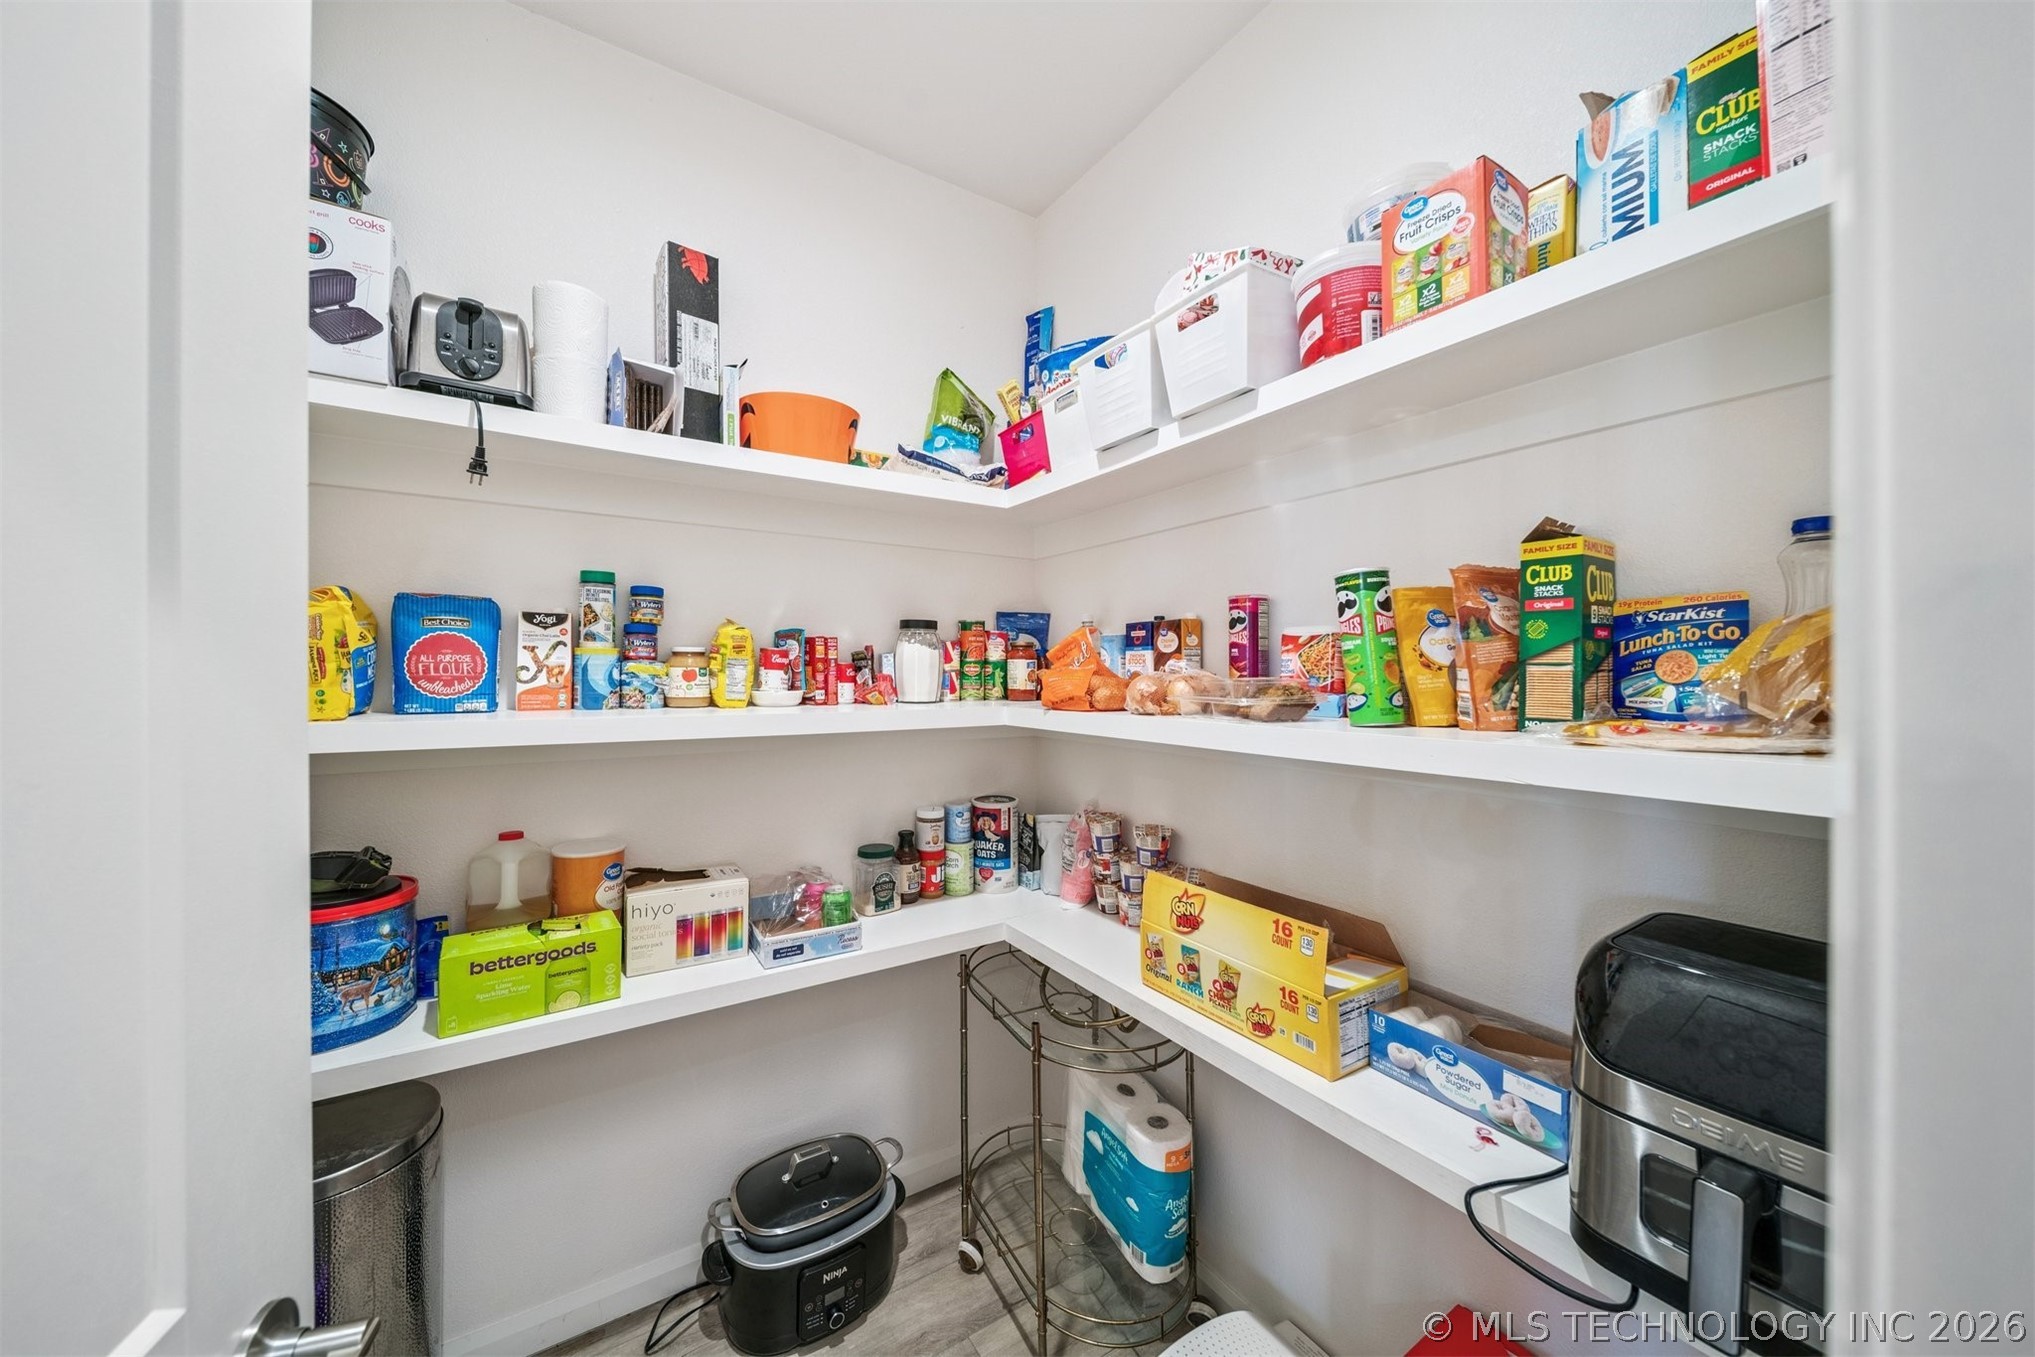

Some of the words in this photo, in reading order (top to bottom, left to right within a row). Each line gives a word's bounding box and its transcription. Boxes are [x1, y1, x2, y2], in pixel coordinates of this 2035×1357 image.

[1691, 48, 1734, 75] FAMILY
[1737, 34, 1758, 51] SIZ
[1695, 88, 1760, 135] CLUB
[1703, 123, 1756, 153] SNACK
[1703, 133, 1758, 162] STACKS
[1649, 163, 1658, 193] GALLETAS
[1705, 166, 1756, 191] ORIGINAL
[1407, 214, 1430, 229] Freeze
[1431, 201, 1452, 216] Dried
[1528, 211, 1558, 229] WHEAT
[348, 216, 386, 233] cooks
[1399, 224, 1422, 243] Fruit
[1425, 205, 1462, 229] Crisps
[1528, 222, 1558, 241] THINS
[1422, 283, 1437, 298] x2
[941, 414, 982, 435] VIBRANT
[1523, 545, 1555, 554] FAMILY
[1556, 542, 1577, 551] SIZE
[1583, 539, 1602, 555] FAMILY
[1525, 564, 1573, 585] CLUB
[1534, 584, 1564, 592] SNACK
[1586, 564, 1615, 603] CLUB
[1533, 600, 1564, 609] Original
[1618, 600, 1633, 609] 19g
[1634, 599, 1663, 608] Protein
[1705, 593, 1743, 602] Calories
[423, 618, 441, 626] Best
[441, 618, 470, 627] Choice
[1646, 607, 1727, 623] StarKist
[1619, 623, 1741, 657] Lunch-To-Go
[1642, 647, 1663, 655] TUNA
[1666, 642, 1694, 650] SALAD
[419, 654, 434, 662] ALL
[437, 654, 472, 662] PURPOSE
[1635, 658, 1653, 666] TUNA
[418, 662, 475, 676] FLOUR
[1631, 664, 1652, 672] SALAD
[417, 677, 474, 694] unbleached
[976, 850, 997, 859] OATS
[930, 865, 945, 883] Ji
[603, 884, 615, 893] Old
[631, 903, 674, 920] hiyo
[1171, 895, 1195, 916] CORN
[631, 922, 663, 933] organic
[1176, 914, 1200, 930] NUTS
[1272, 918, 1294, 939] 16
[631, 931, 657, 942] social
[658, 928, 684, 938] tonics
[1271, 933, 1293, 950] COUNT
[1302, 937, 1313, 948] 130
[468, 941, 597, 976] bettergoods
[547, 966, 588, 979] bettergoods
[1145, 963, 1173, 984] Original
[475, 987, 510, 1001] Sparkling
[510, 983, 532, 994] Water
[495, 981, 513, 990] Lime
[1175, 978, 1204, 999] RANCH
[1279, 985, 1299, 1005] 16
[1208, 997, 1232, 1013] PICANTE
[1280, 1000, 1300, 1016] COUNT
[1246, 1006, 1267, 1024] CORN
[1373, 1013, 1386, 1027] 10
[1435, 1063, 1481, 1091] Powdered
[1444, 1075, 1471, 1093] Sugar
[823, 1266, 848, 1285] NINJA
